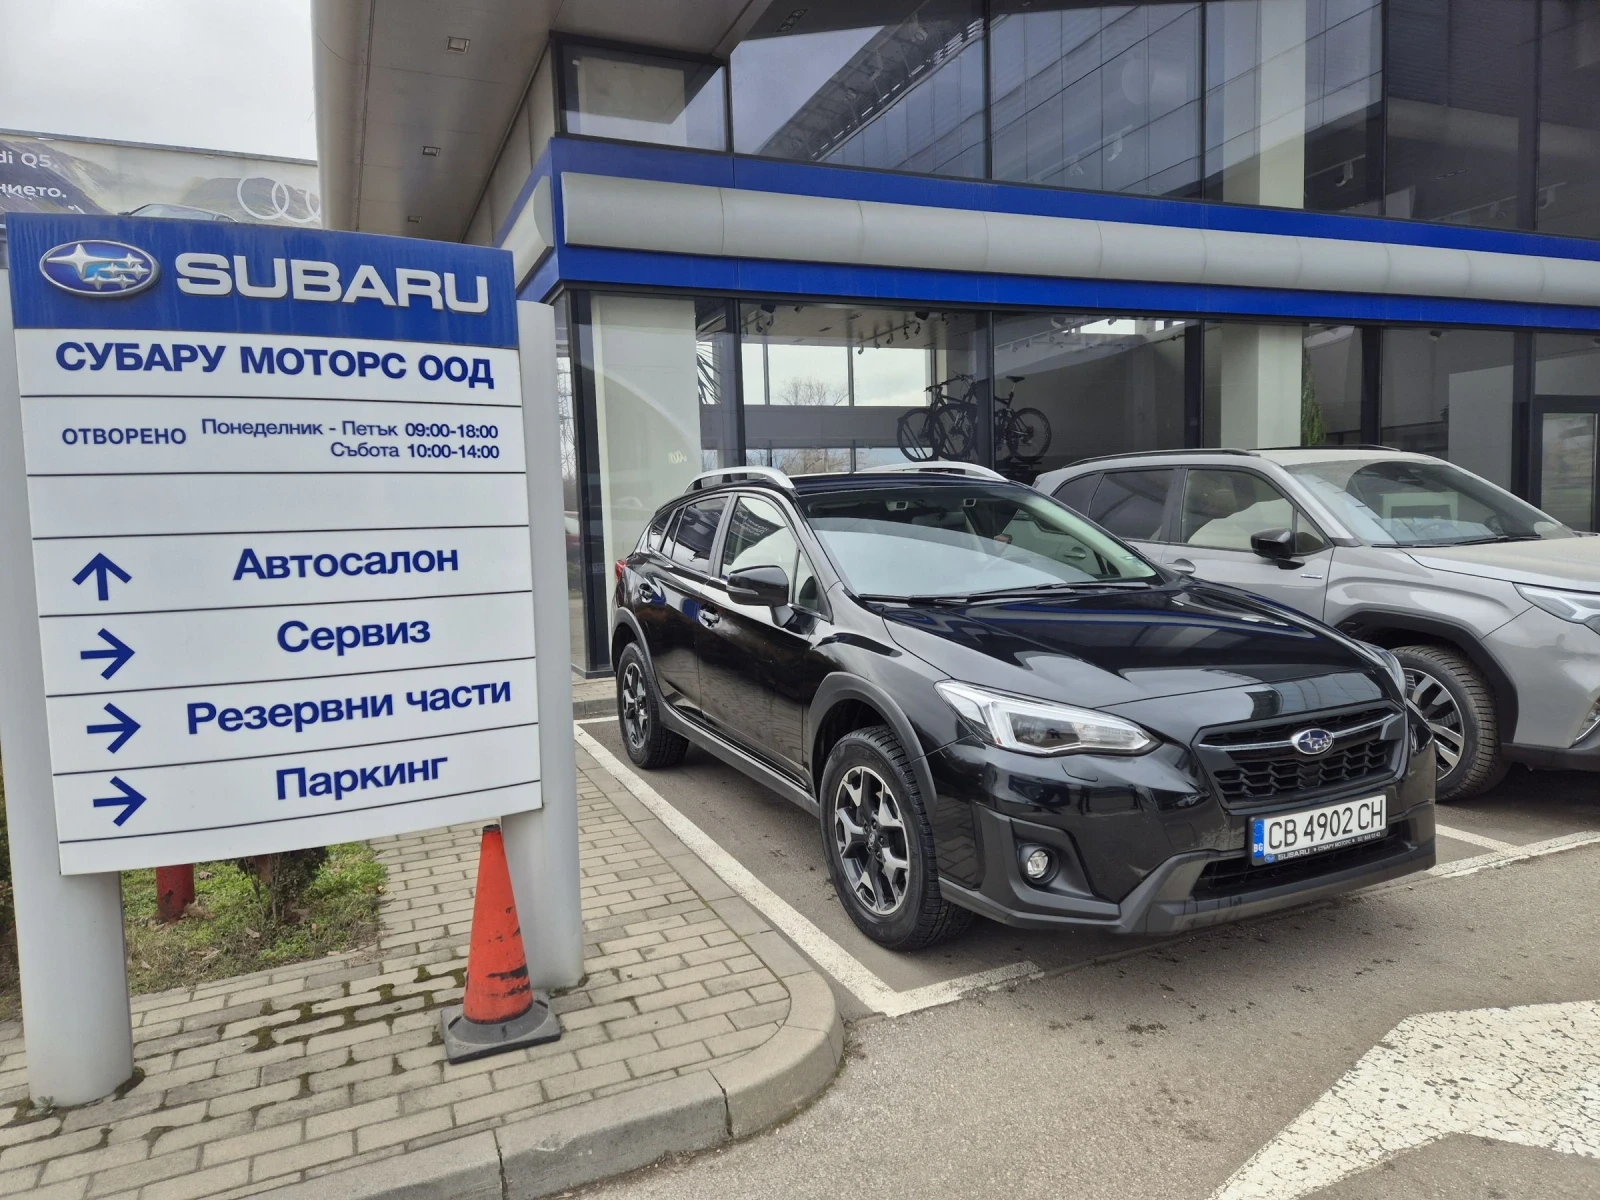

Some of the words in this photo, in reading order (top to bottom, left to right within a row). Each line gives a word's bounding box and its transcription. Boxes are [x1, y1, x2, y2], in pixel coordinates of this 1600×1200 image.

[21, 153, 58, 169] Q5.
[175, 253, 489, 314] SUBARU
[56, 342, 226, 372] СУБАРУ
[241, 346, 407, 379] МОТОРС
[418, 354, 494, 389] ООД
[62, 428, 186, 445] ОТВОРЕНО
[202, 419, 323, 437] Понеделник
[342, 421, 398, 436] Петък
[405, 423, 498, 438] 09:00-18:00
[331, 442, 400, 457] Събота
[408, 444, 499, 458] 10:00-14:00
[233, 549, 458, 580] Автосалон
[277, 621, 430, 656] Сервиз
[187, 694, 393, 734] Резервни
[406, 682, 510, 712] части
[276, 757, 448, 800] Паркинг
[1268, 818, 1298, 850] CB
[1303, 807, 1354, 843] 4902
[1357, 799, 1384, 831] CH
[1253, 843, 1264, 853] BG
[1277, 848, 1310, 861] SUBARU
